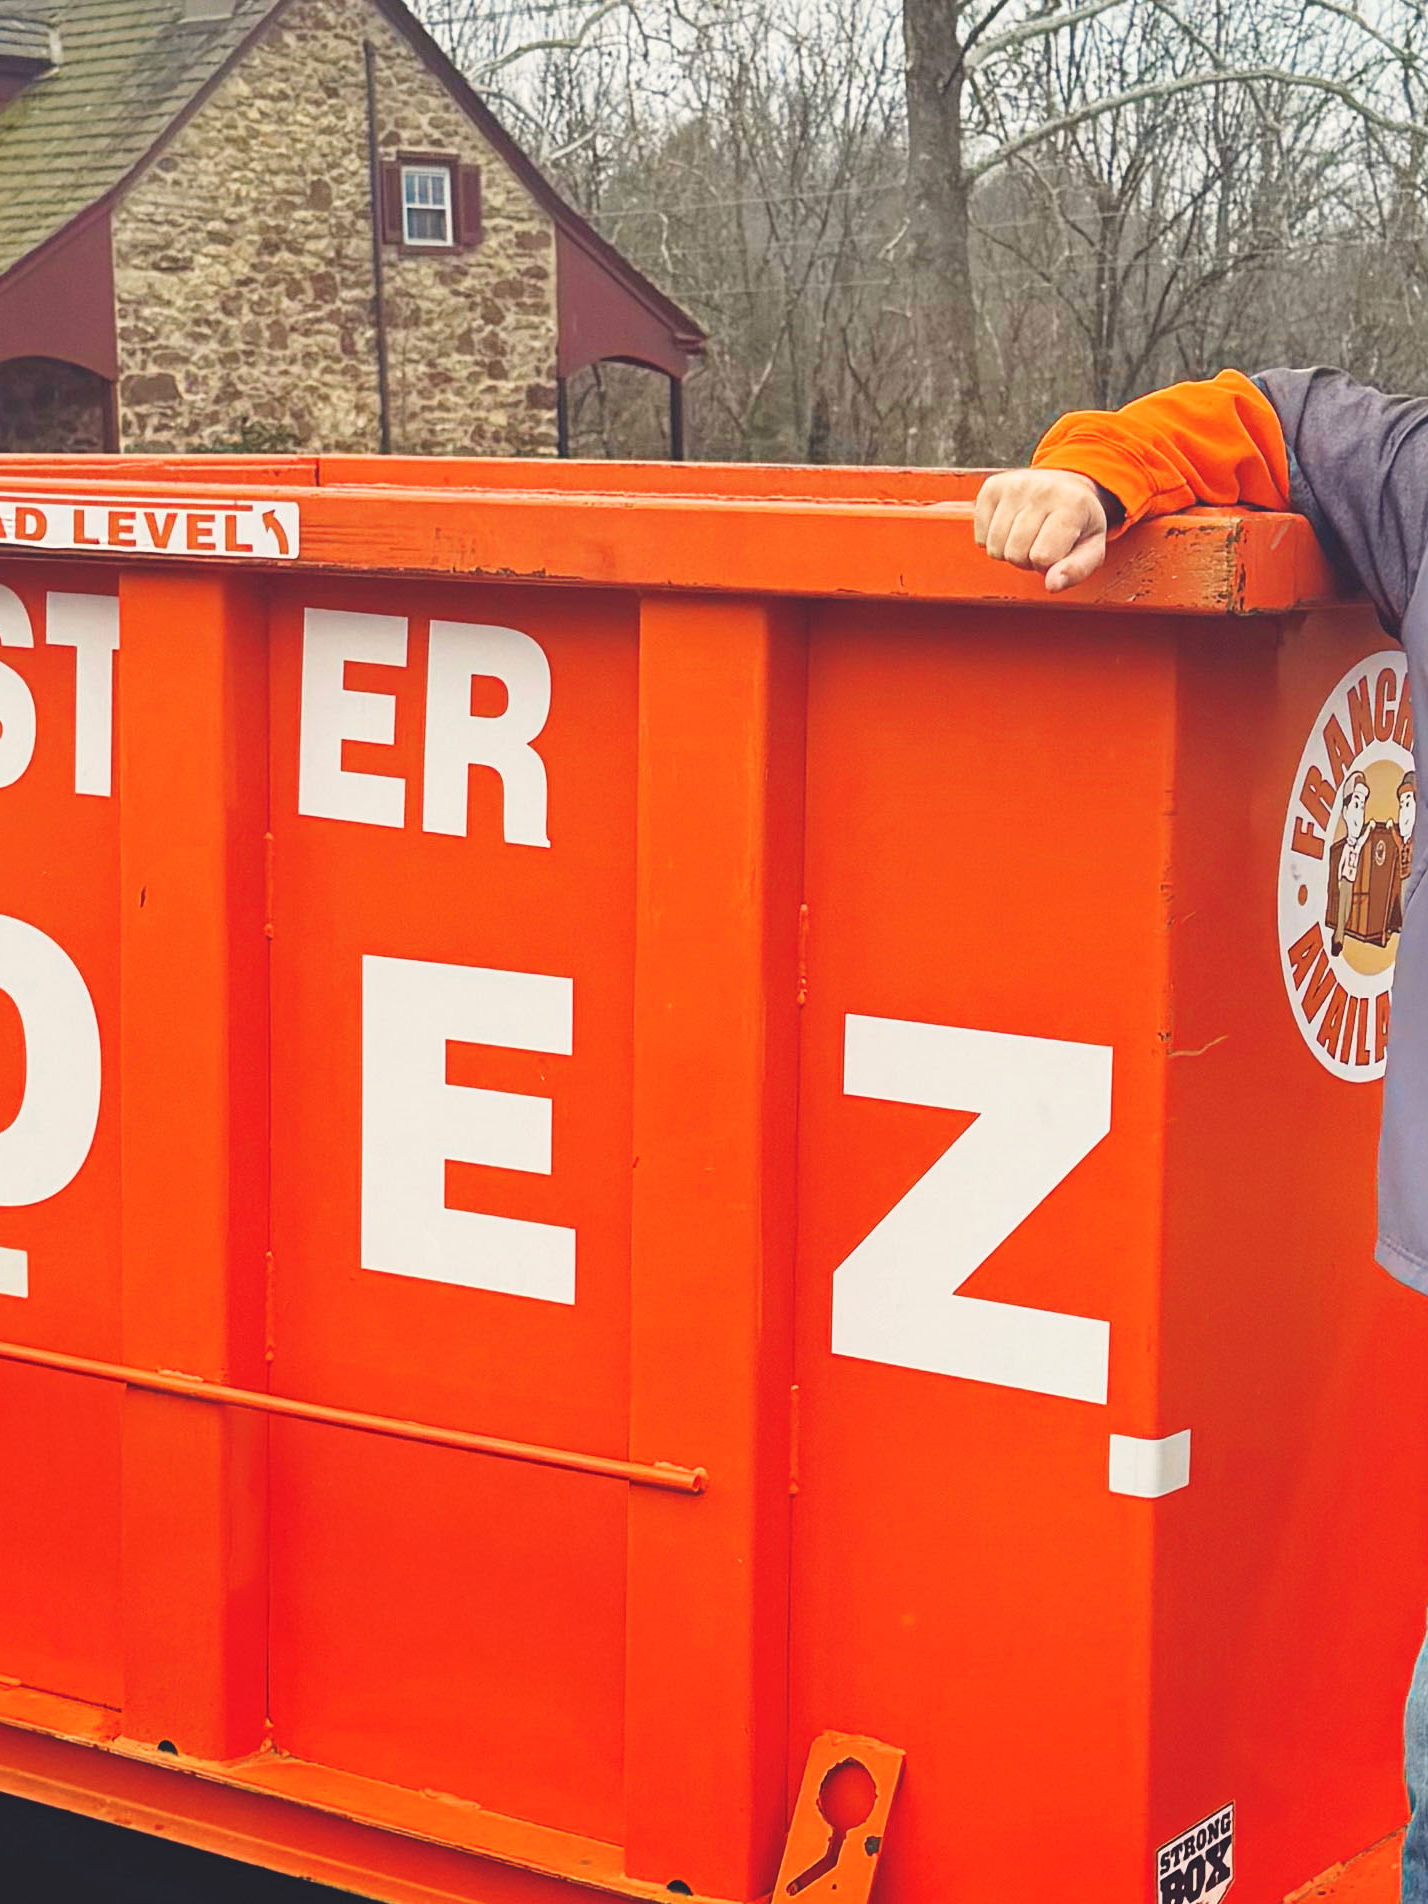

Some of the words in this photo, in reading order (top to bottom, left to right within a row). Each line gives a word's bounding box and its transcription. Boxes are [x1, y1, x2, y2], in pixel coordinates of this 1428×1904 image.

[73, 511, 254, 553] LEVEL
[1291, 668, 1415, 861] FRANCH
[1287, 921, 1391, 1066] AVAILA
[1160, 1811, 1231, 1876] STRONG
